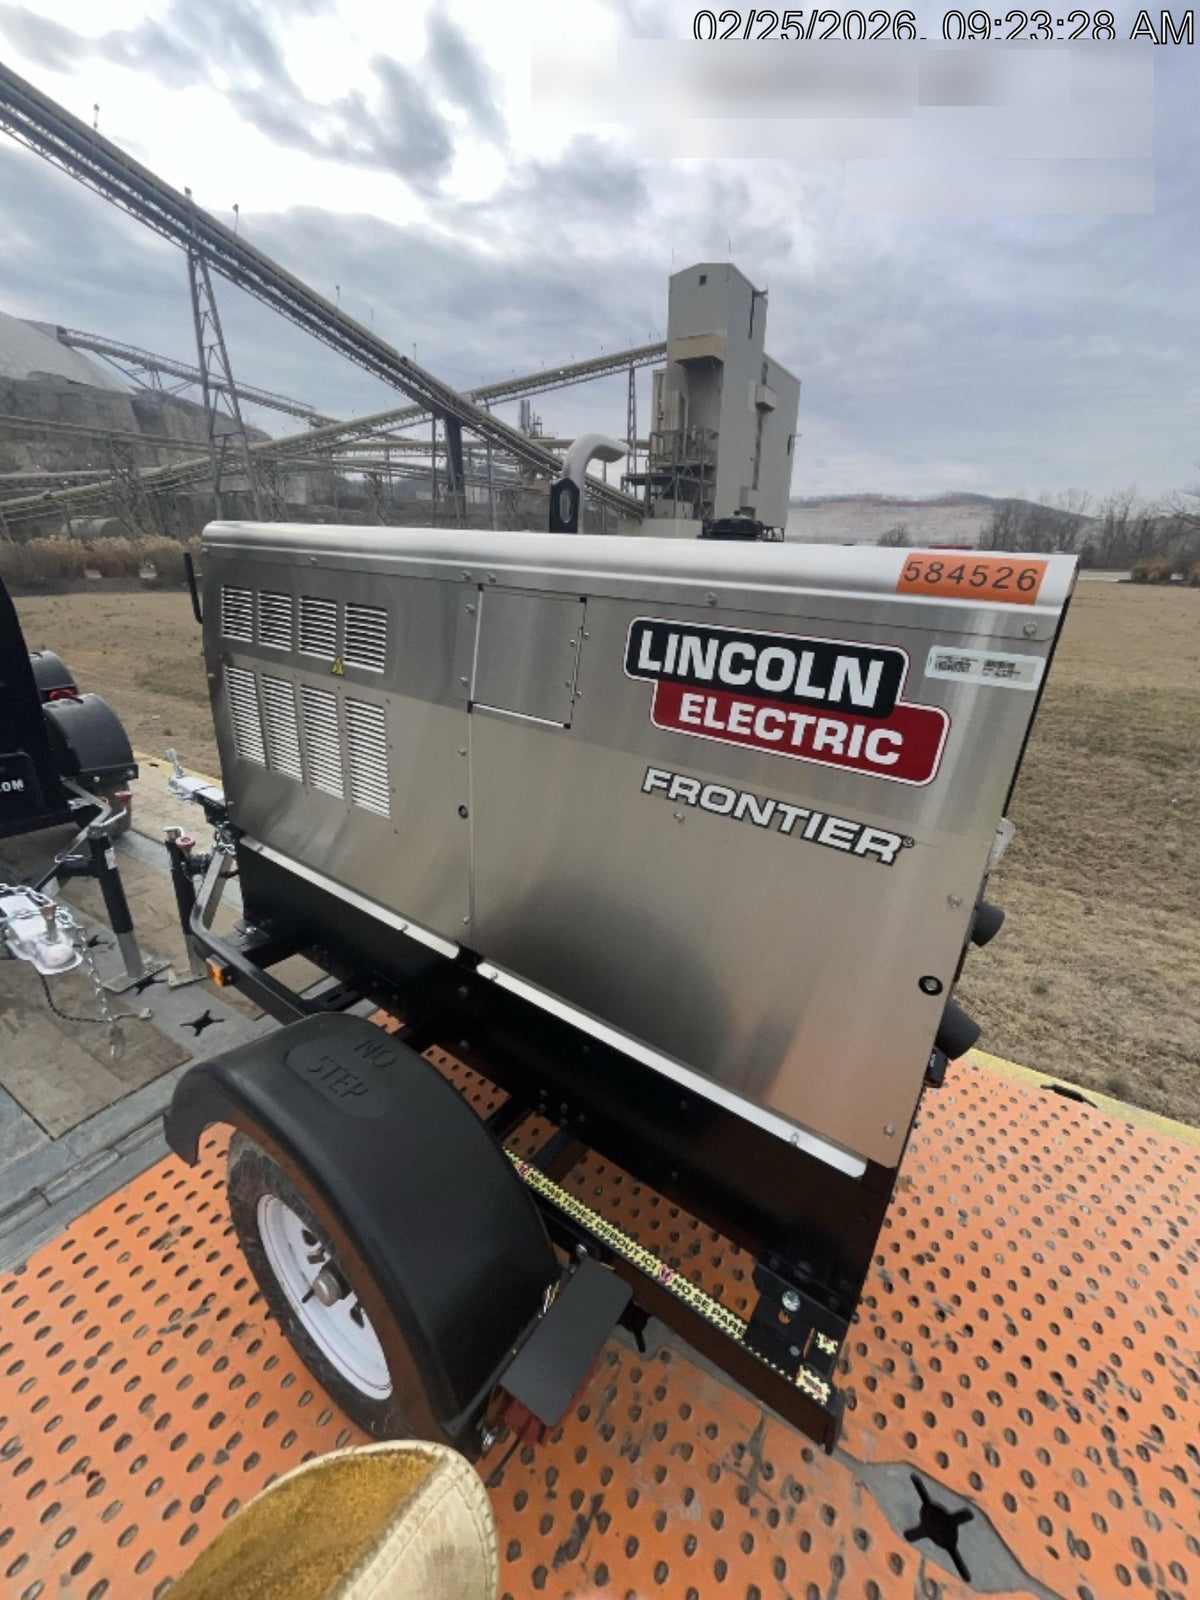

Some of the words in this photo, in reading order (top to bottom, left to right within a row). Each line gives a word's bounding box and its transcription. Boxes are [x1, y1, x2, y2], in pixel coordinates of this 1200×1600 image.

[903, 560, 1039, 592] 584526
[637, 628, 884, 709] LINCOLN
[678, 693, 904, 767] ELECTRIC
[0, 779, 24, 792] OM
[353, 1039, 397, 1068] NO
[306, 1055, 370, 1098] STEP
[595, 1221, 641, 1256] DEBOUT
[641, 1254, 657, 1270] ICI
[672, 1278, 692, 1296] NO
[693, 1293, 712, 1312] SE
